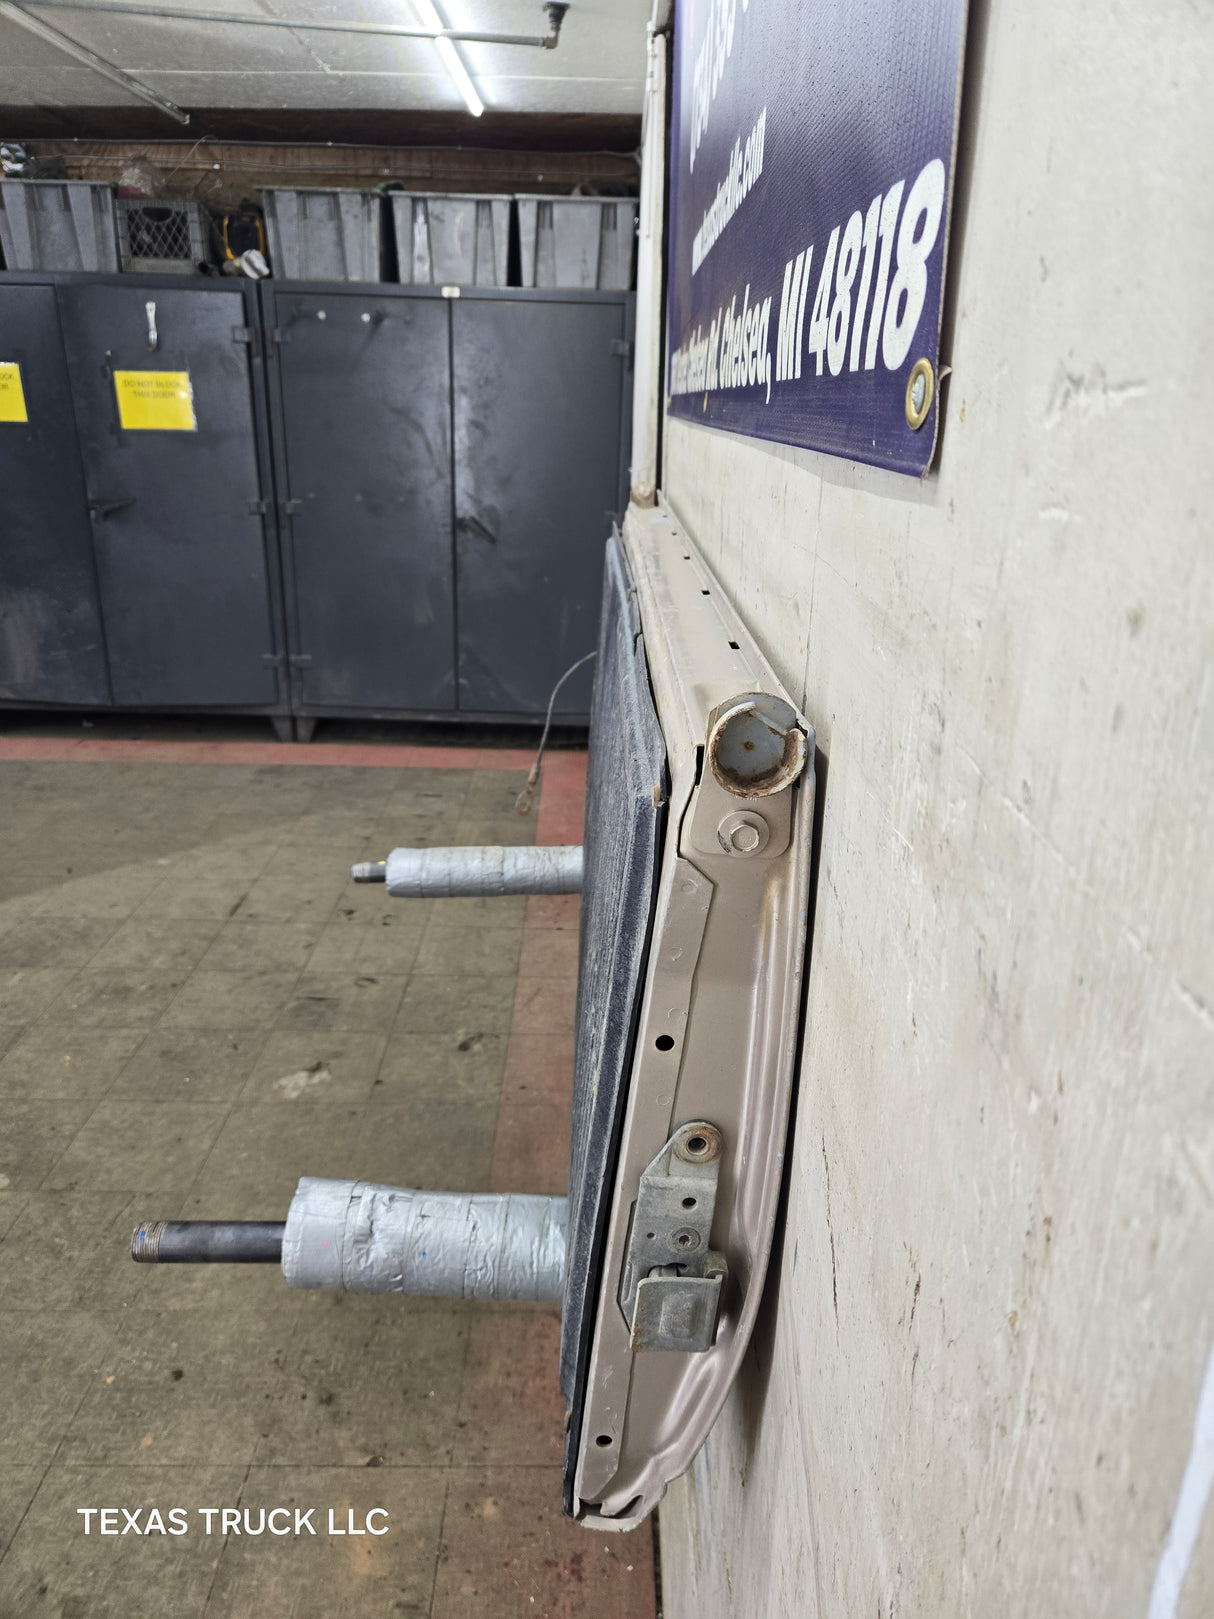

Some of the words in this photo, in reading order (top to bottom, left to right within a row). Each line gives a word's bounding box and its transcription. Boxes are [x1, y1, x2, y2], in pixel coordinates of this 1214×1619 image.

[719, 283, 772, 404] Chelsea,
[776, 245, 814, 381] MI
[809, 158, 945, 376] 48118
